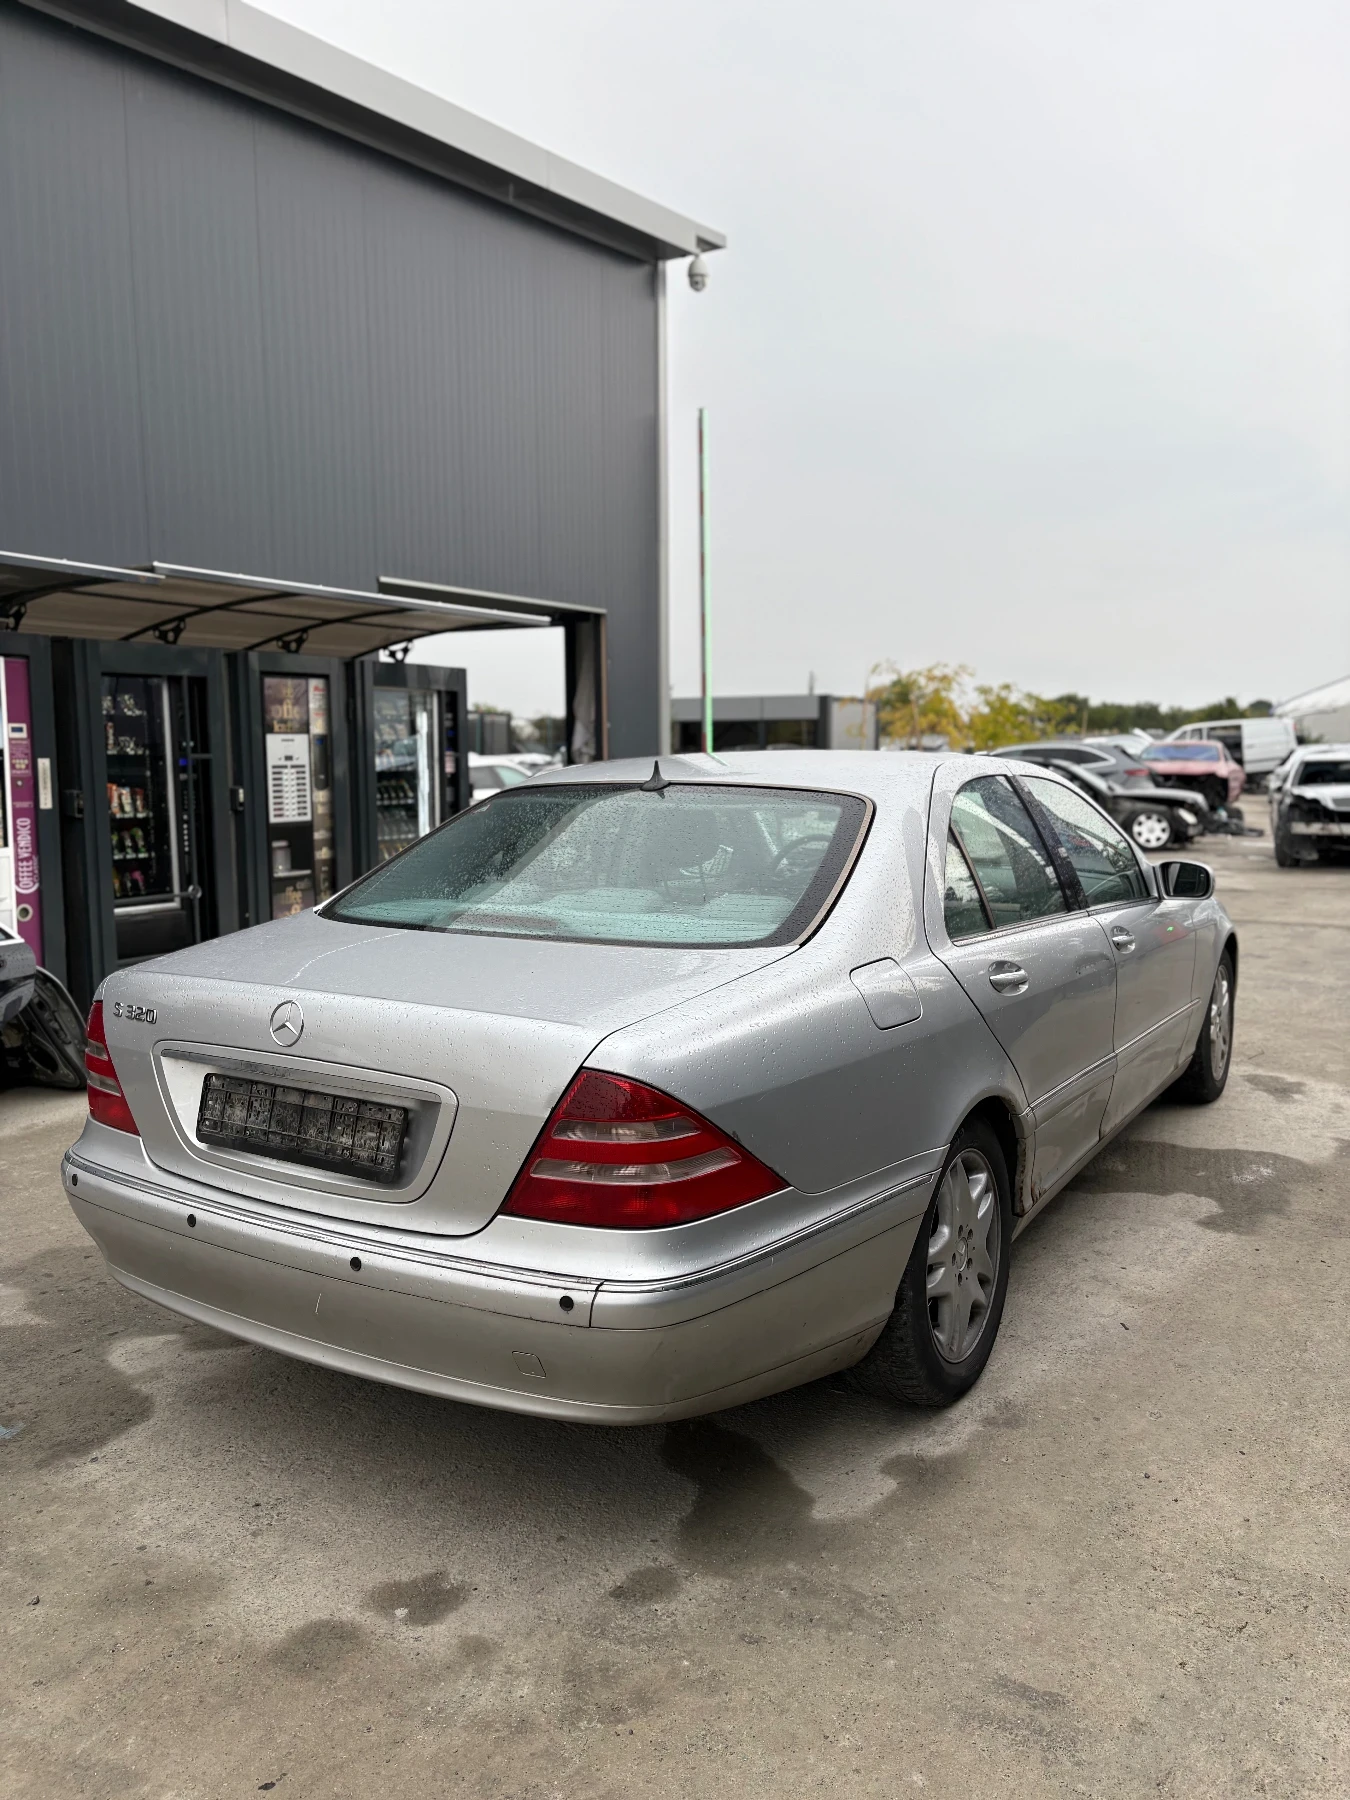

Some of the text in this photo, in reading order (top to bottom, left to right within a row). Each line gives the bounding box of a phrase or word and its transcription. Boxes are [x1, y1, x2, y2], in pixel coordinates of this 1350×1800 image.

[16, 817, 32, 859] VENDICO
[14, 859, 39, 894] COFFEE
[113, 1002, 158, 1025] S 320
